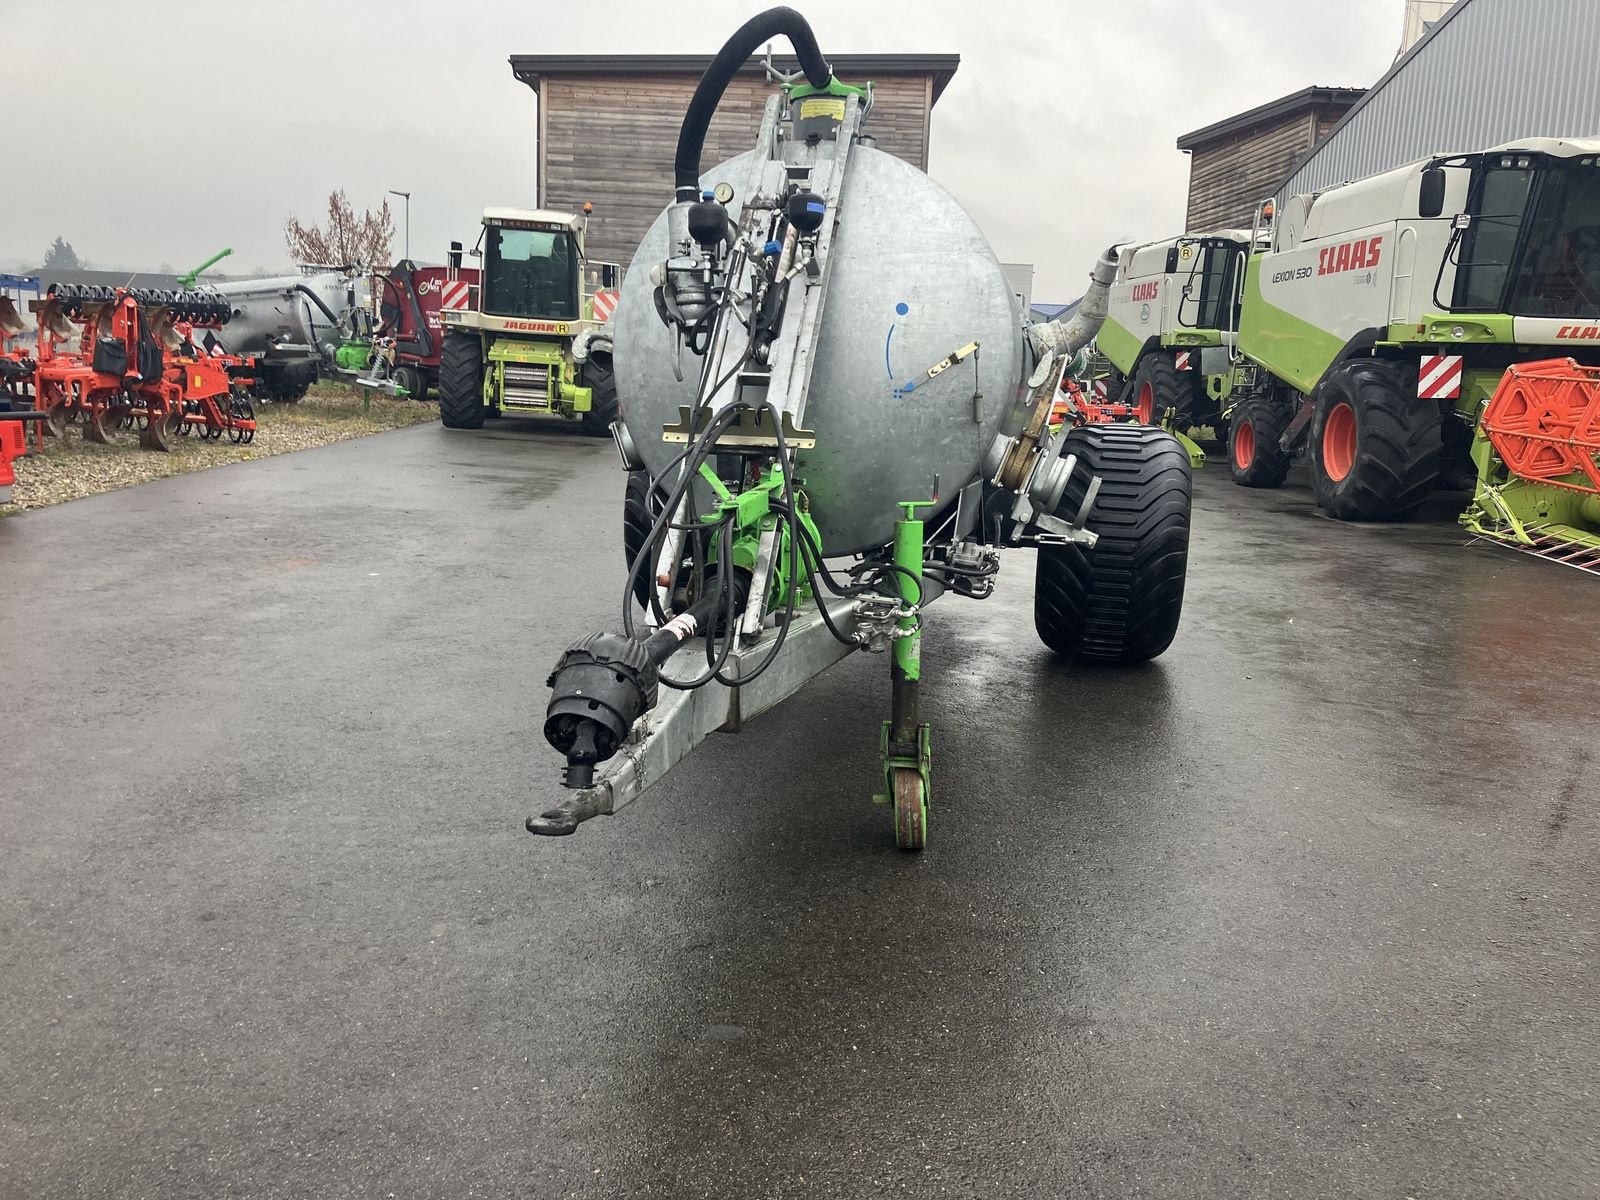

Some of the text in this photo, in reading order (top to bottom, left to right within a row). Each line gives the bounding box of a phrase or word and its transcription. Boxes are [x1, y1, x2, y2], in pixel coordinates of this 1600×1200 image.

[1318, 236, 1383, 276] CLAAS
[1272, 266, 1313, 284] LEXION 530
[1132, 281, 1159, 302] CLAAS
[503, 321, 555, 332] JAGUAR
[1556, 326, 1600, 339] CLA
